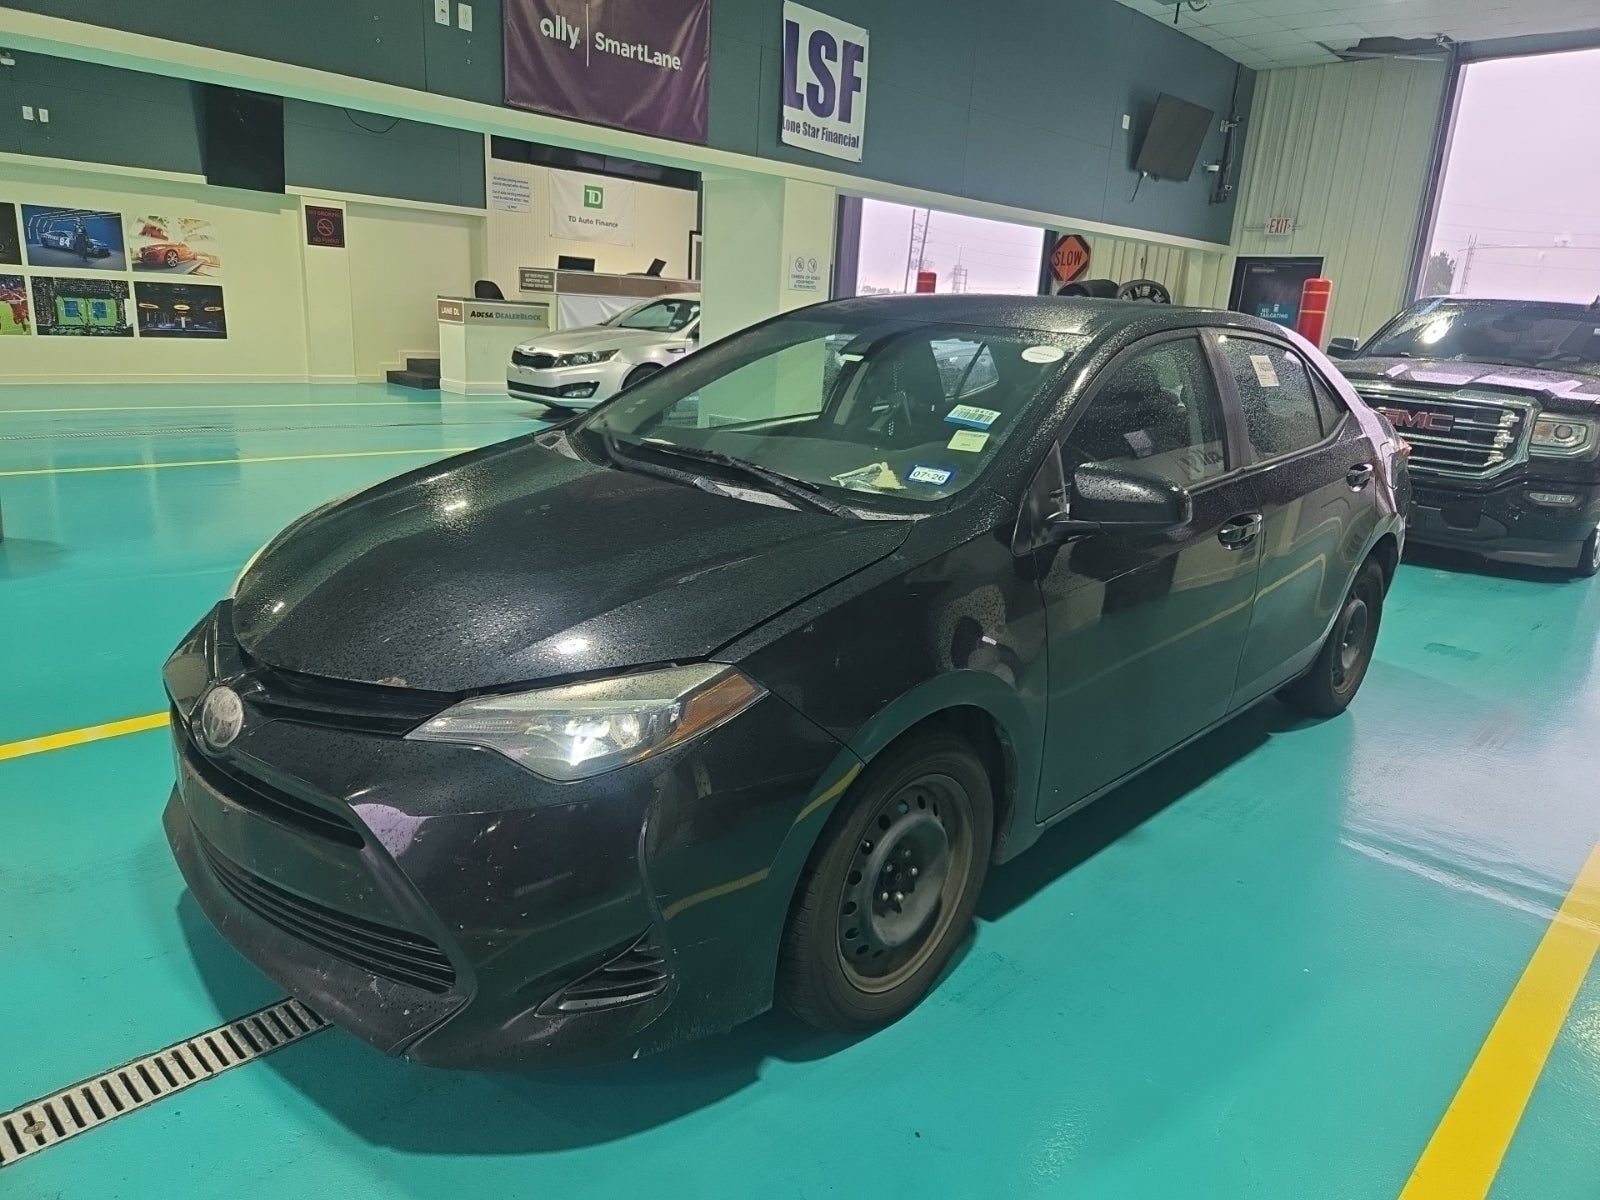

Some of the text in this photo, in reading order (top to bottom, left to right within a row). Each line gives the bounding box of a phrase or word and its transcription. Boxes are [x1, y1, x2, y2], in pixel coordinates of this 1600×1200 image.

[540, 14, 580, 49] ally
[595, 31, 681, 70] SmartLane
[783, 19, 864, 124] LSF
[802, 121, 820, 139] Star
[821, 127, 859, 149] Financial
[586, 189, 602, 205] TD
[568, 215, 618, 228] TD Auto Finance
[1269, 218, 1289, 234] EXIT
[59, 237, 71, 247] 84
[1054, 250, 1082, 266] SLOW
[441, 306, 453, 315] LANE
[470, 310, 494, 319] ADESA
[1375, 407, 1454, 432] GMC
